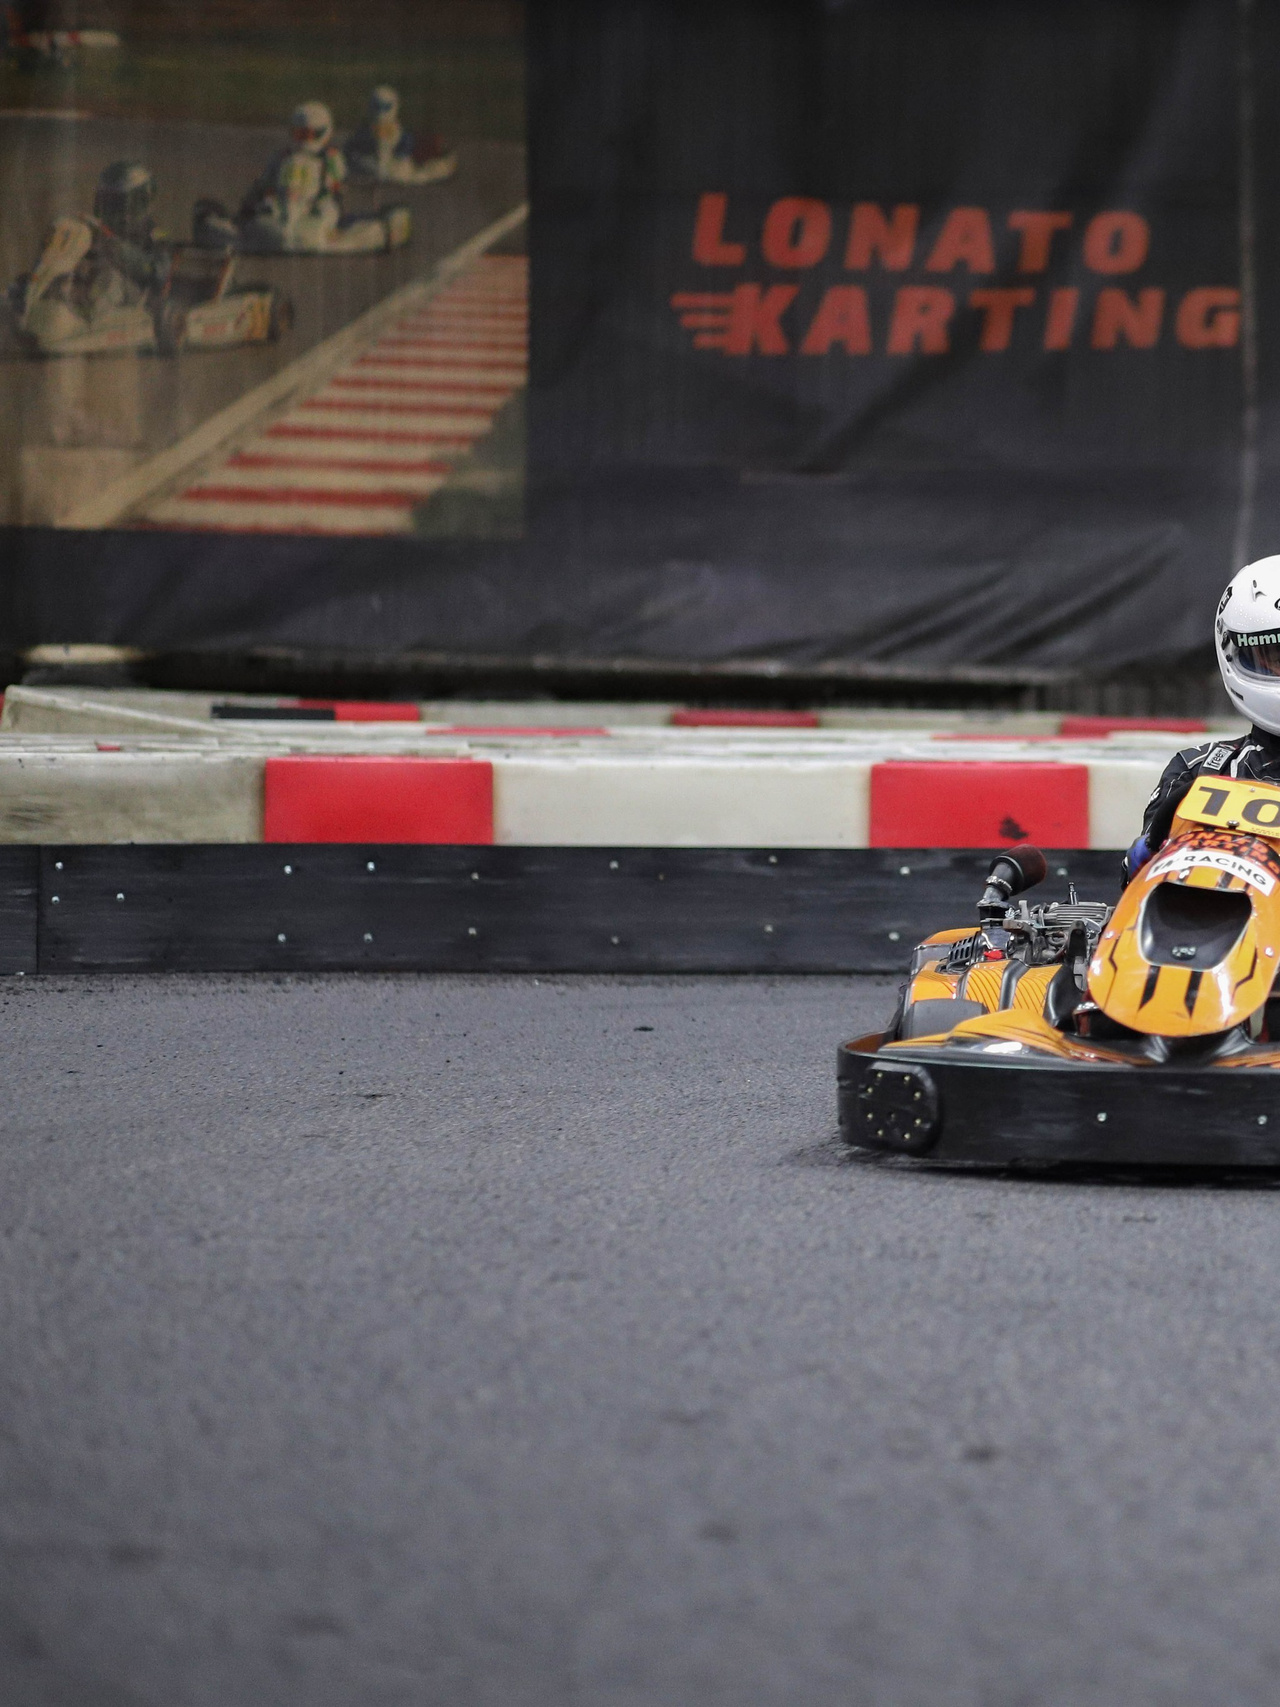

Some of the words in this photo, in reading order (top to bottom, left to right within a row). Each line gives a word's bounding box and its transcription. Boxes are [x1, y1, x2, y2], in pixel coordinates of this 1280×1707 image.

[692, 193, 1150, 275] LONATO
[715, 283, 1243, 355] KARTING
[1184, 855, 1267, 885] RACING
